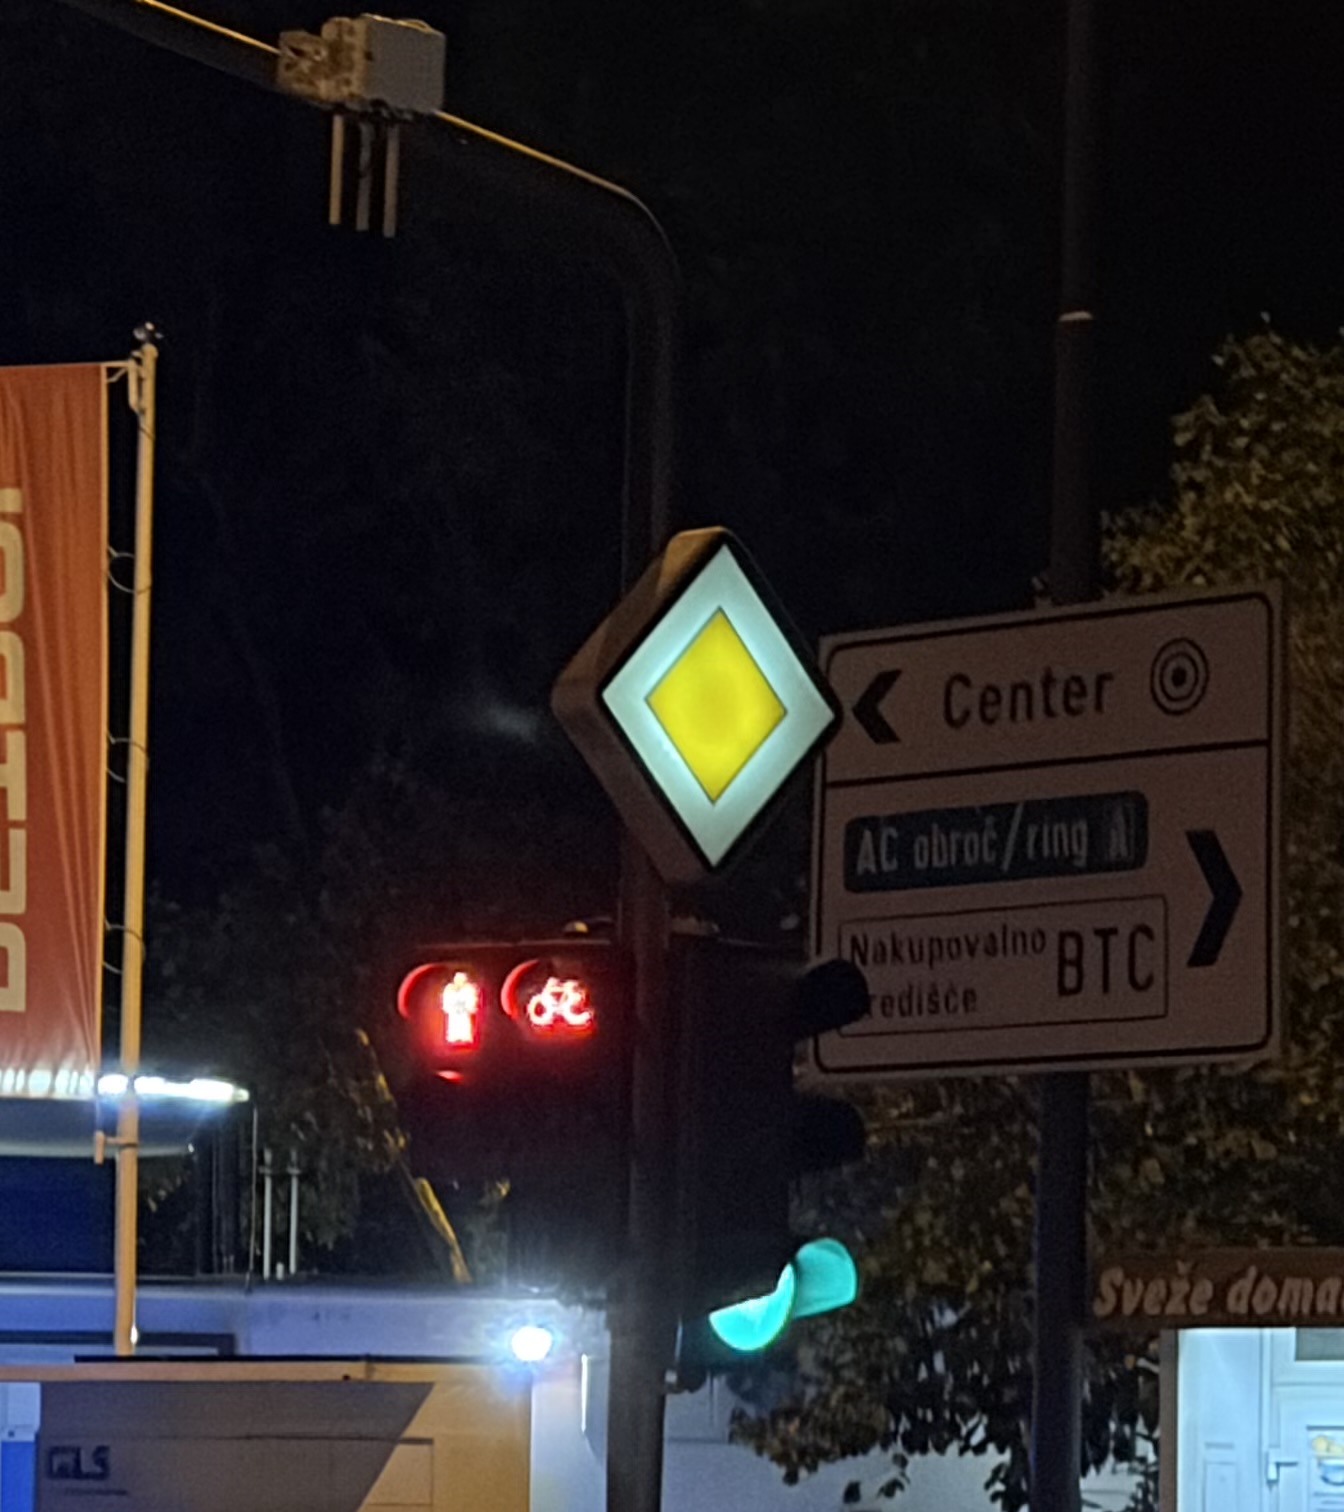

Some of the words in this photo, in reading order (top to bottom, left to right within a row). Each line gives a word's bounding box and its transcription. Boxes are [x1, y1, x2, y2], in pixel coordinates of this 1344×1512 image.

[943, 665, 1115, 730] Center
[855, 826, 900, 876] AC
[848, 923, 1047, 970] Nakupovalno
[1056, 922, 1156, 997] BTC
[1092, 1259, 1214, 1318] Sveže
